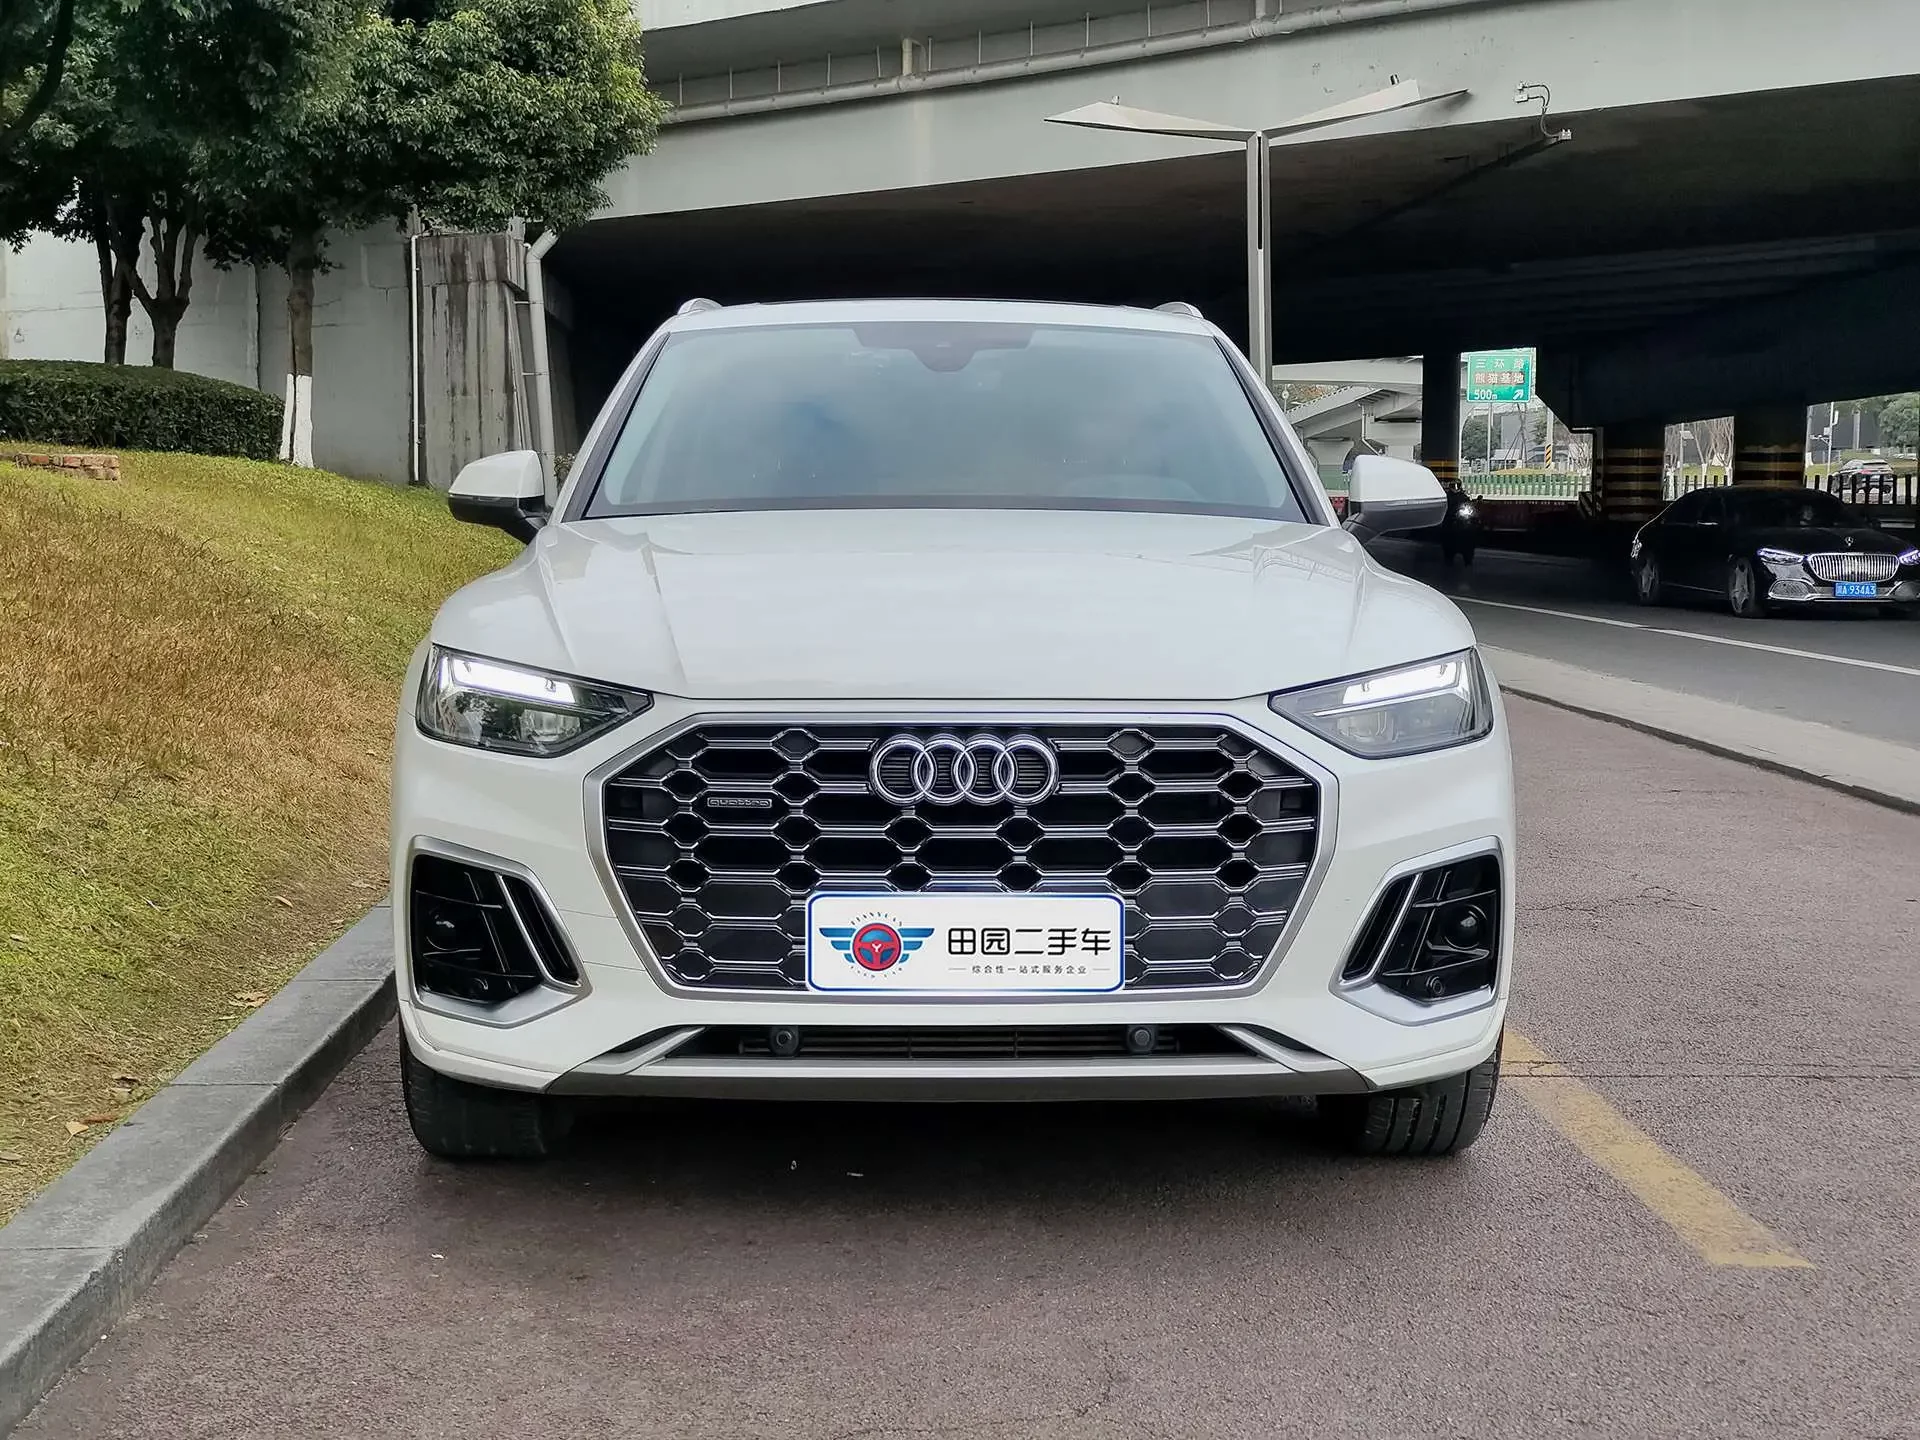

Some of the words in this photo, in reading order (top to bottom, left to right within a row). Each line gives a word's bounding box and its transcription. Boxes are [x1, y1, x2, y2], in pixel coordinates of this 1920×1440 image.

[948, 927, 1111, 956] 田园二手车
[971, 965, 1087, 975] 综合性一站式服务企业
